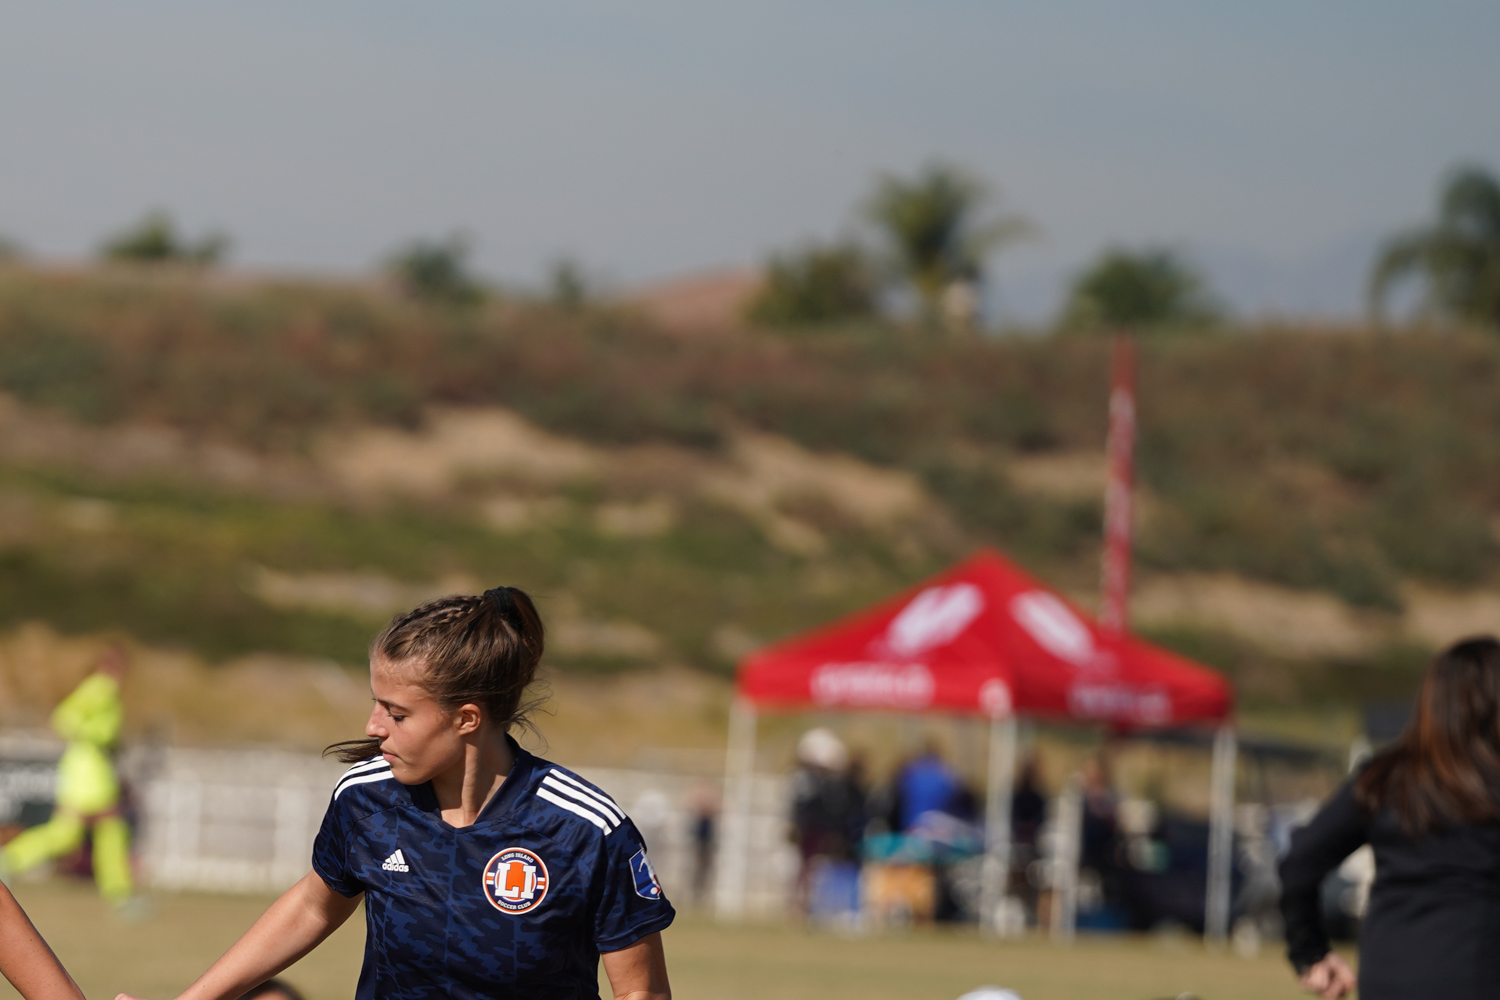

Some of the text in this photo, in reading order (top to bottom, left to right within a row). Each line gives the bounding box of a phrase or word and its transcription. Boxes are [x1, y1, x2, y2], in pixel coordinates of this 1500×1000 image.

[515, 853, 534, 863] ISLAND
[382, 863, 409, 872] adidas
[495, 863, 536, 899] LI
[497, 900, 531, 909] SOCCER CLUB
